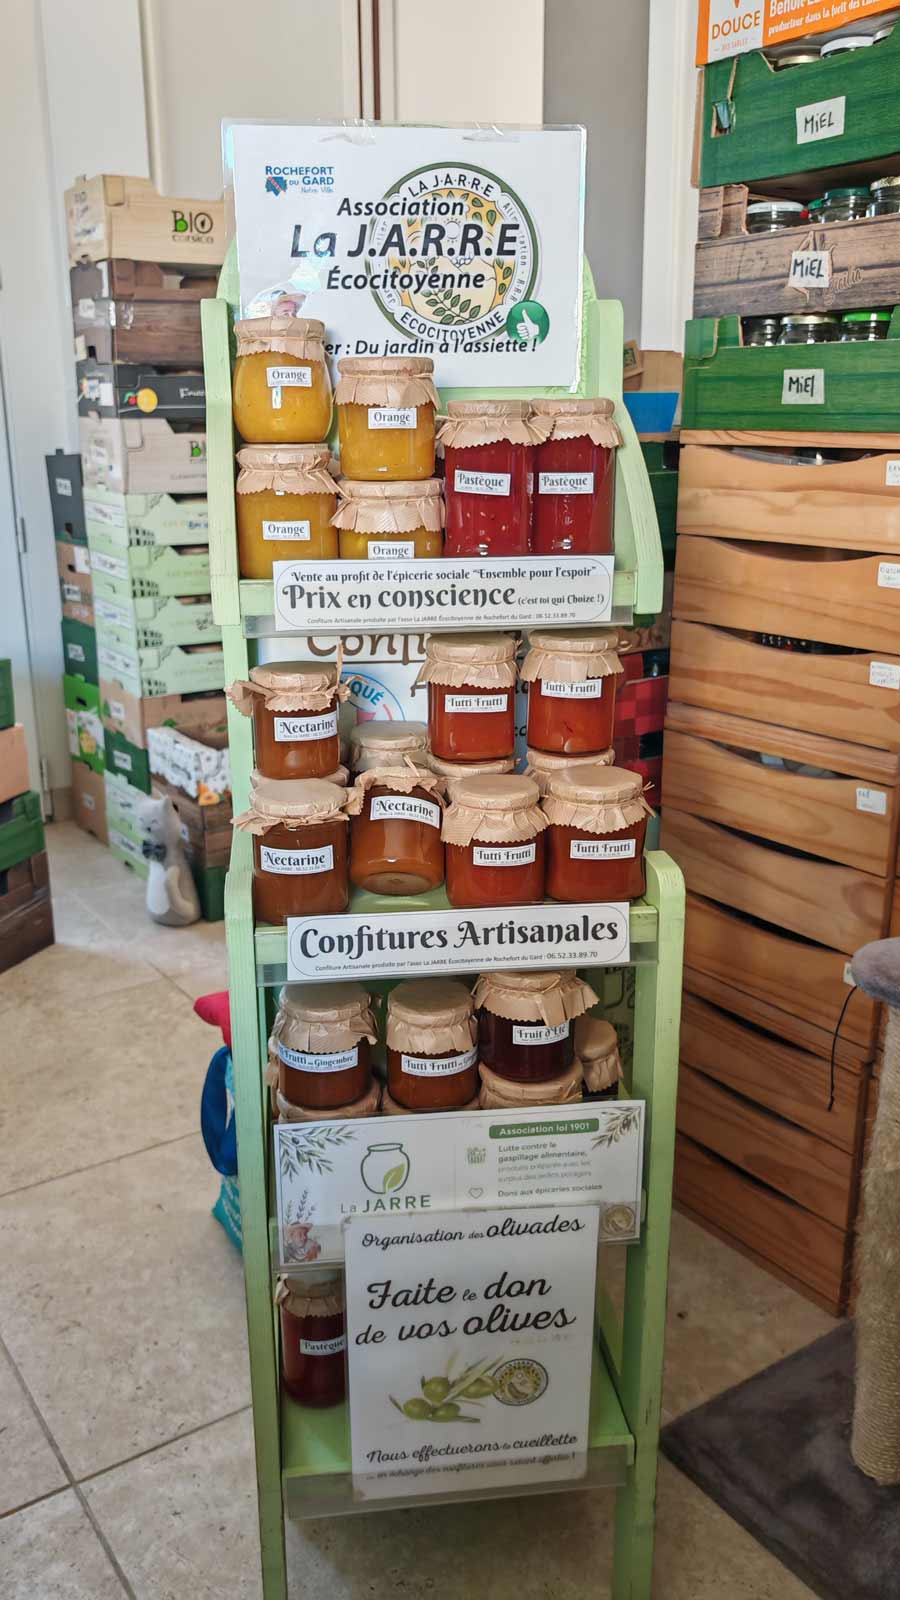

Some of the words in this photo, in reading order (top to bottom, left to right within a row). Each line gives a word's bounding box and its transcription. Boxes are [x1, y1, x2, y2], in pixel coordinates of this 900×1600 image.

[805, 12, 821, 24] dans
[822, 8, 830, 18] la
[711, 10, 761, 39] DOUCE
[265, 166, 335, 175] ROCHEFORT
[302, 176, 335, 185] GARD
[408, 180, 429, 198] LA
[336, 197, 464, 216] Association
[171, 210, 214, 234] BIO
[290, 224, 337, 258] La
[347, 224, 520, 257] J.A.R.R.E
[327, 265, 485, 294] Écocitoyenne
[400, 310, 505, 342] ECOCITOYENNE
[324, 343, 342, 355] er
[355, 340, 379, 355] Du
[382, 339, 434, 357] jardin
[438, 339, 450, 353] à
[454, 338, 528, 353] l'assiette
[272, 370, 307, 386] Orange
[373, 411, 411, 425] Orange
[267, 523, 305, 537] Orange
[372, 545, 410, 558] Orange
[291, 571, 323, 582] Vente
[325, 573, 338, 582] au
[341, 570, 370, 584] profit
[373, 571, 386, 581] de
[388, 570, 433, 583] l'épicerie
[435, 568, 470, 580] sociale
[529, 569, 551, 581] pour
[282, 584, 342, 609] Prix
[347, 593, 371, 609] en
[378, 583, 516, 609] conscience
[551, 595, 565, 606] qui
[350, 679, 384, 706] QUÉ
[568, 683, 596, 692] Frutti
[447, 698, 472, 707] Tutti
[474, 697, 503, 707] Frutti
[279, 719, 335, 735] Nectarine
[376, 799, 434, 817] Nectarine
[476, 850, 501, 861] Tutti
[503, 847, 531, 860] Frutti
[573, 843, 599, 853] Tutti
[601, 842, 631, 853] Frutti
[263, 851, 325, 866] Nectarine
[300, 924, 448, 960] Confitures
[453, 914, 619, 949] Artisanales
[546, 951, 598, 960] 06.52.33.89.70
[429, 1060, 458, 1071] Frutti
[499, 1124, 555, 1136] Association
[556, 1124, 568, 1133] loi
[570, 1122, 590, 1132] 1901
[498, 1145, 520, 1153] Lutte
[521, 1142, 548, 1151] contre
[498, 1153, 539, 1164] gaspillage
[540, 1150, 588, 1160] alimentaire,
[497, 1190, 519, 1198] Dons
[535, 1186, 571, 1195] épiceries
[572, 1183, 603, 1192] sociales
[341, 1203, 357, 1214] La
[361, 1194, 432, 1213] JARRE
[361, 1228, 466, 1250] Organisation
[468, 1230, 484, 1239] des
[486, 1214, 586, 1238] olivades
[367, 1277, 457, 1310] Faite
[462, 1288, 478, 1302] le
[483, 1271, 552, 1301] don
[355, 1324, 387, 1346] de
[397, 1319, 459, 1342] vos
[462, 1303, 577, 1336] olives
[366, 1449, 410, 1463] Nous
[412, 1442, 500, 1462] effectuerons
[512, 1433, 578, 1449] cueillette
